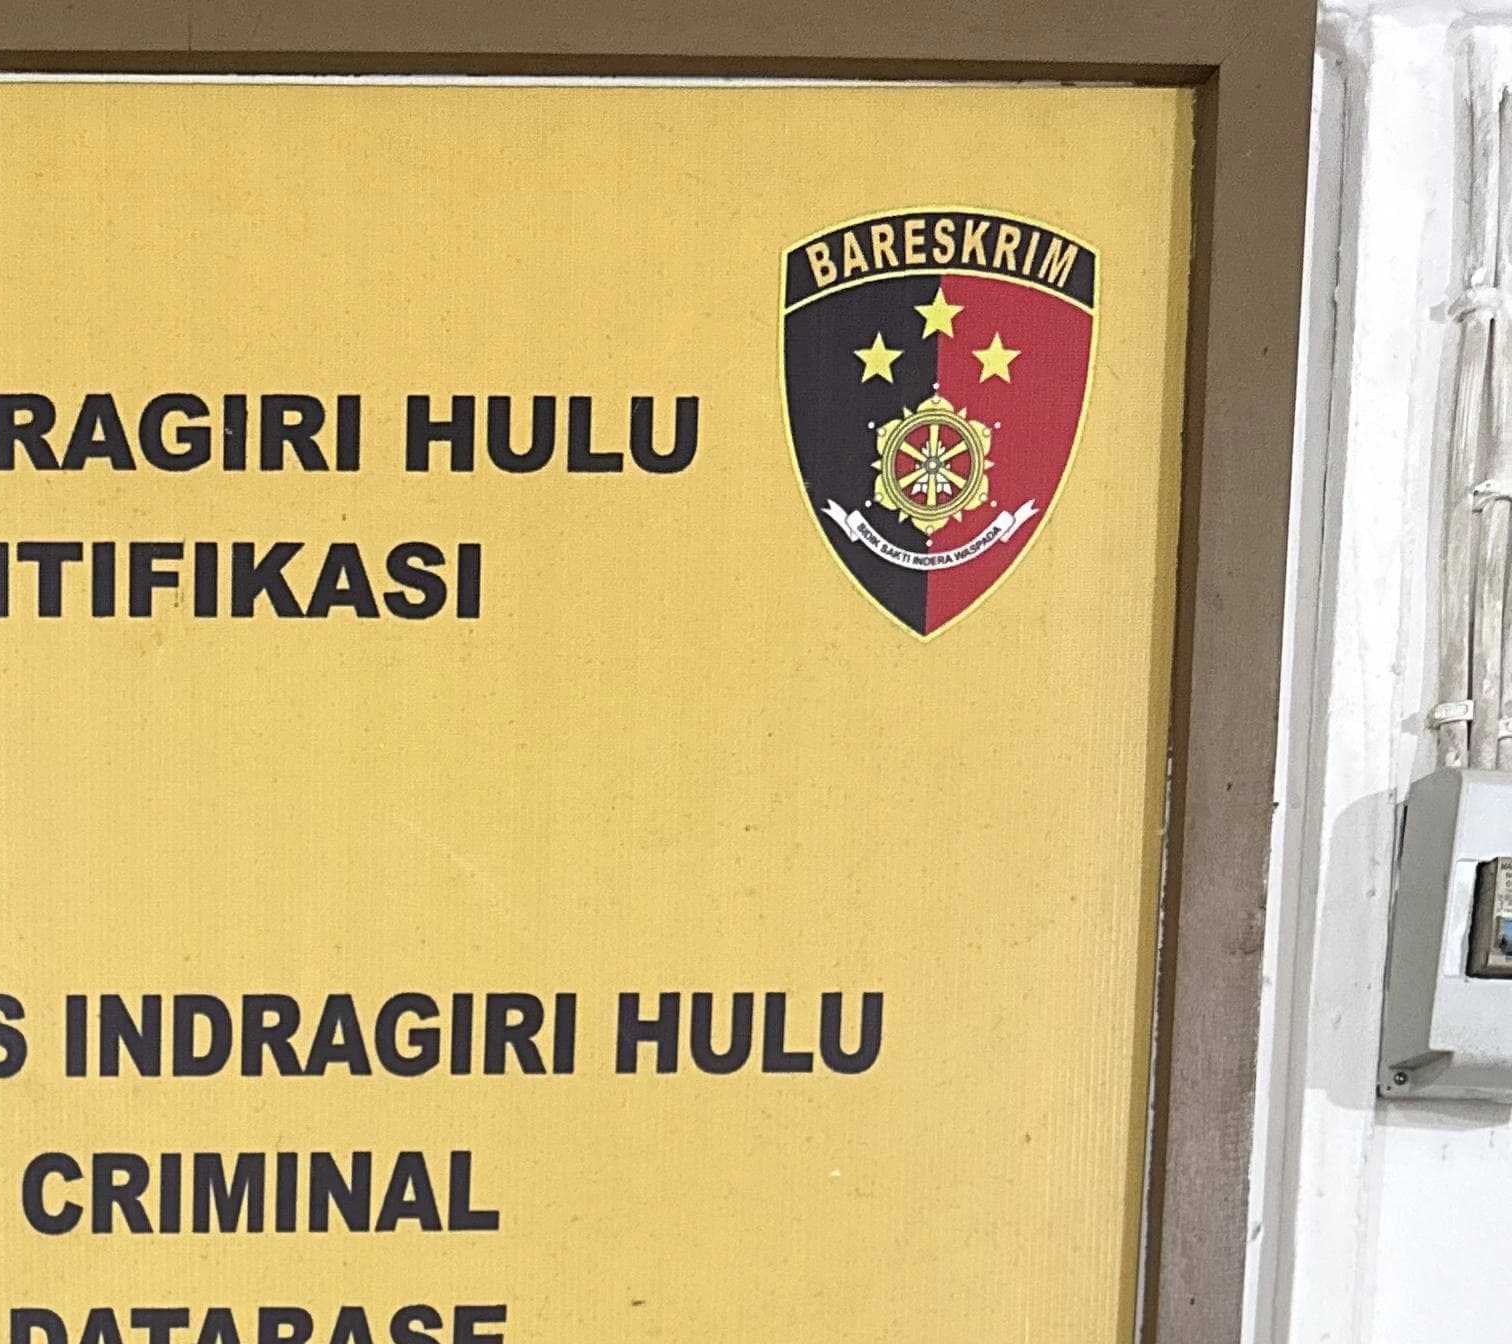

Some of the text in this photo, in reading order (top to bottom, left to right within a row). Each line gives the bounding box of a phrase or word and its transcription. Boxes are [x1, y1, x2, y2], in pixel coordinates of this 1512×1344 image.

[805, 218, 1079, 289] BARESKRIM
[405, 394, 700, 474] HULU
[856, 523, 1002, 566] SIDIK SAKTI INDERA WASPADA
[66, 992, 577, 1077] INDRAGIRI
[615, 991, 884, 1075] HULU
[22, 1150, 500, 1235] CRIMINAL
